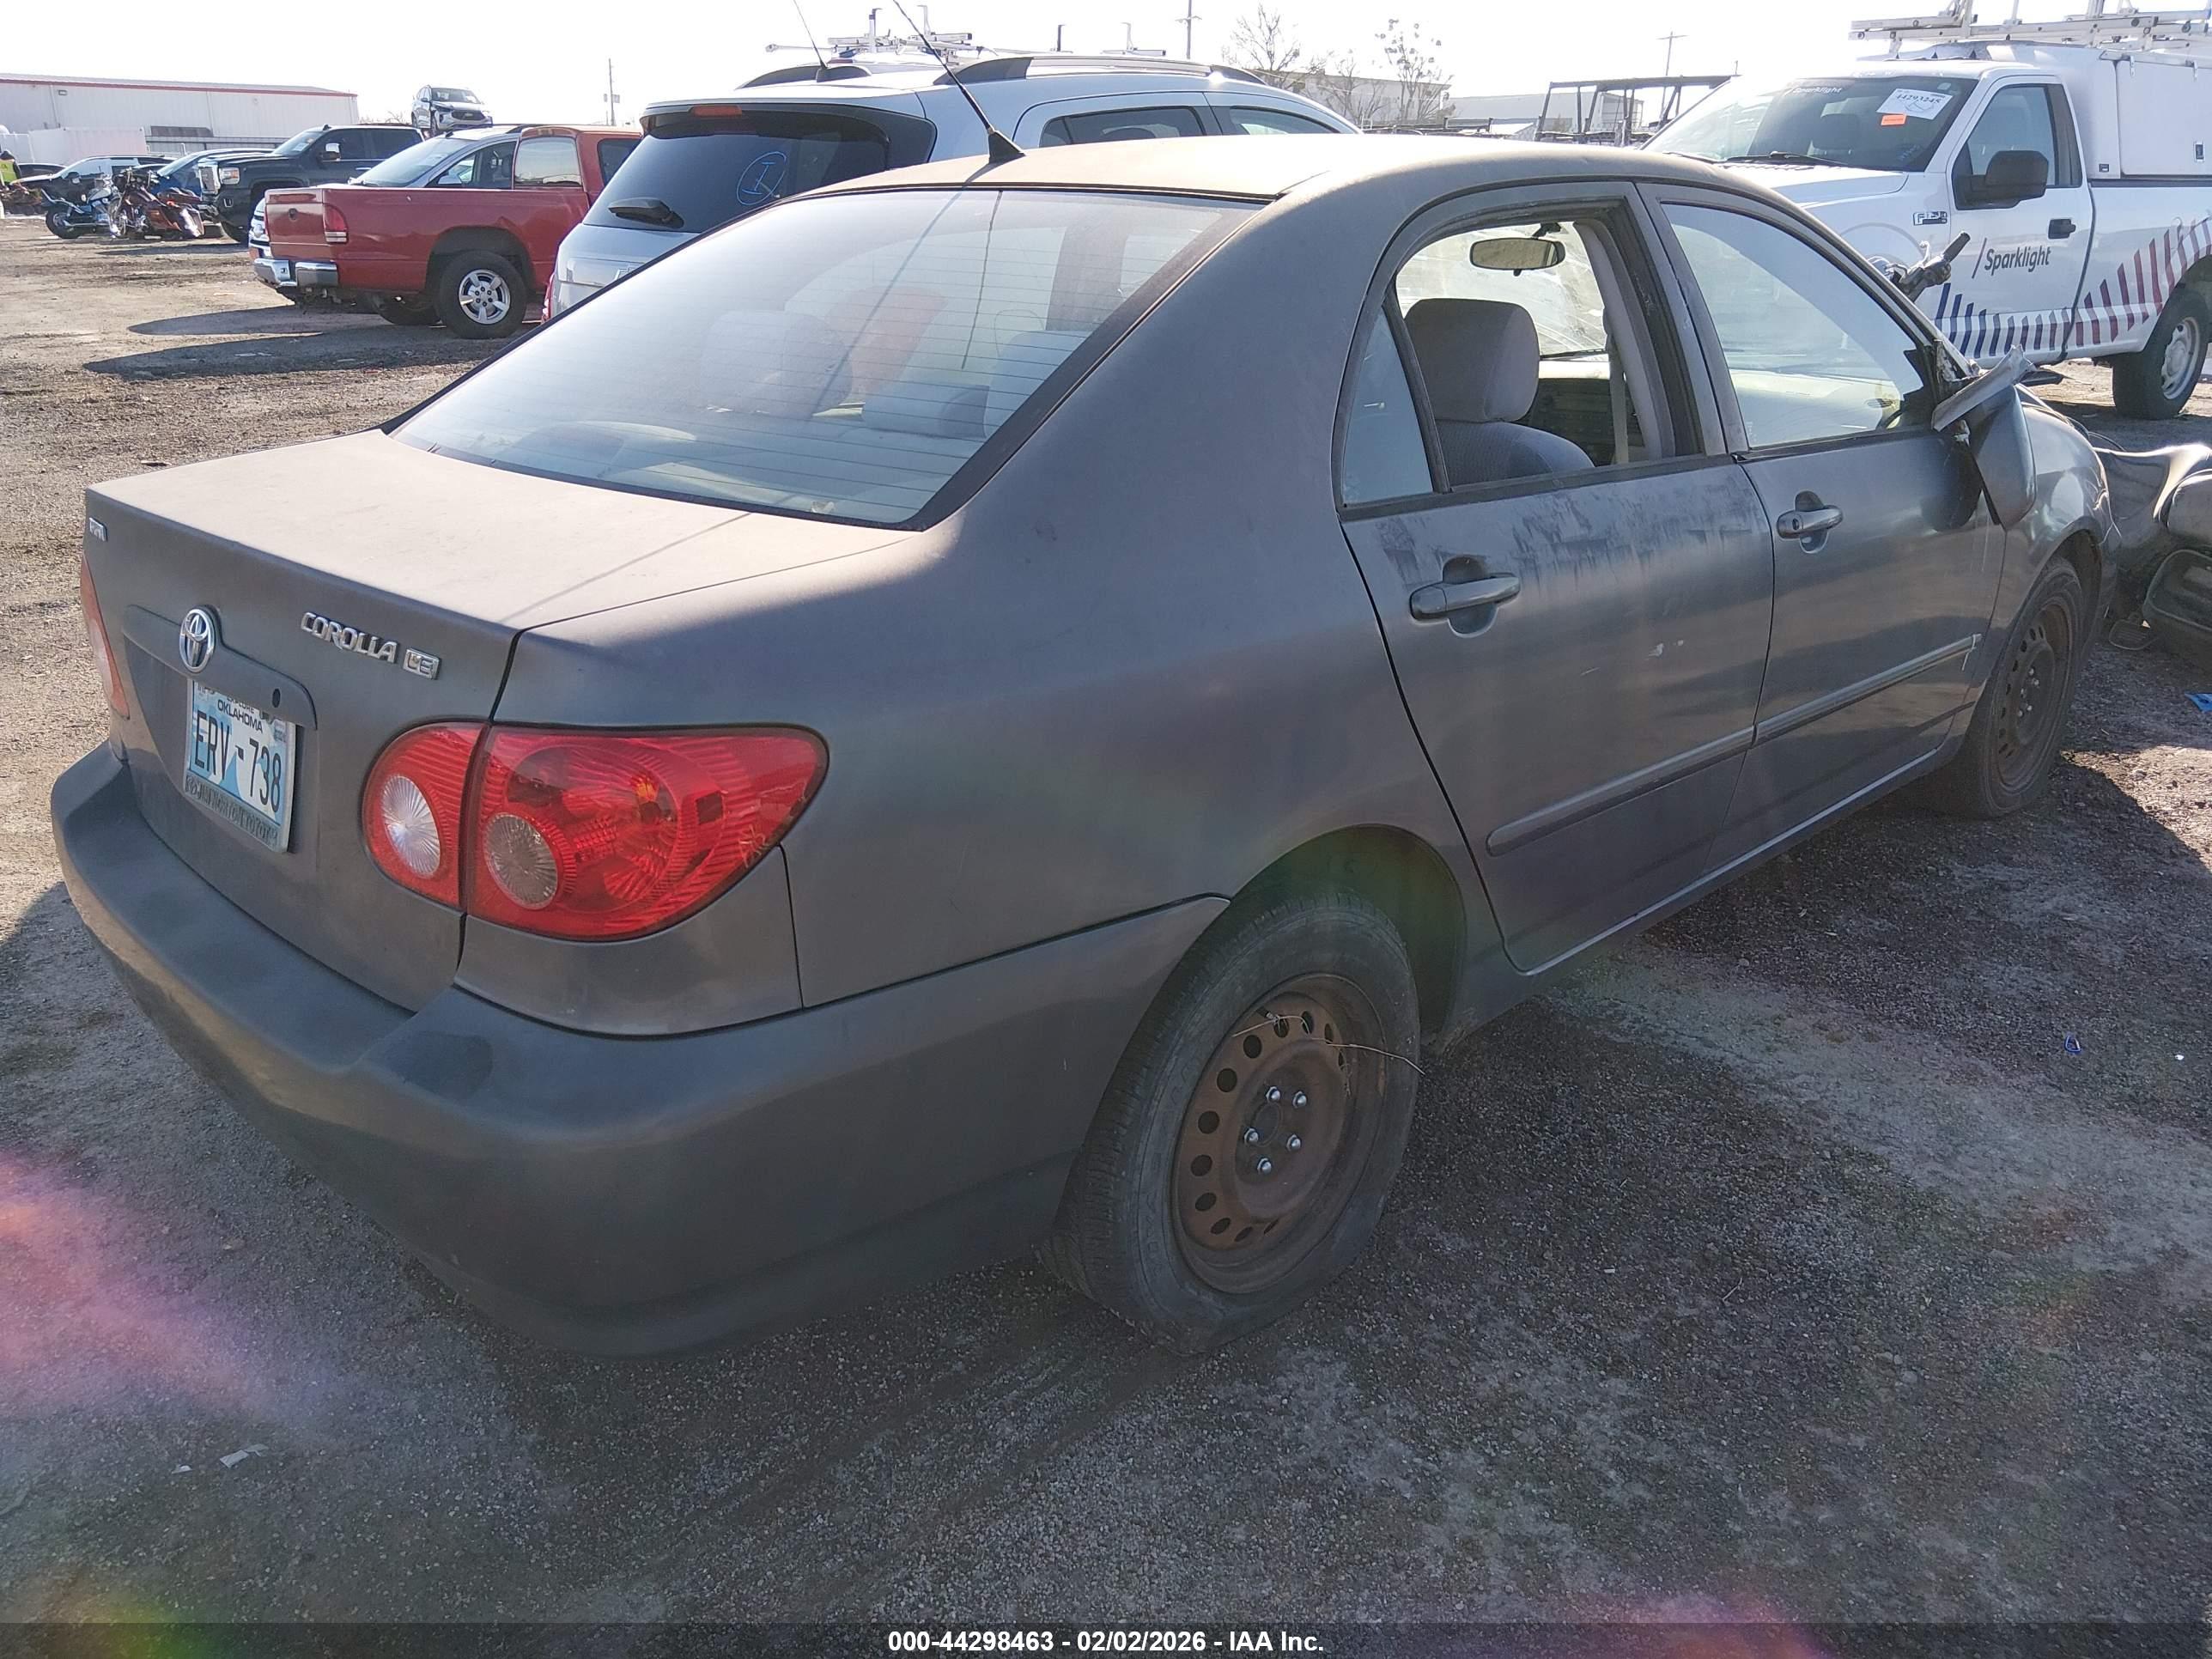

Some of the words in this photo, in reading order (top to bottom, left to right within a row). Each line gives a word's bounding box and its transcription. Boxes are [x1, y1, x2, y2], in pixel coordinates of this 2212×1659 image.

[1984, 246, 2051, 276] Sparklight
[301, 611, 398, 664] COROLLA
[403, 648, 440, 679] LE
[217, 698, 264, 733] OKLAHOMA
